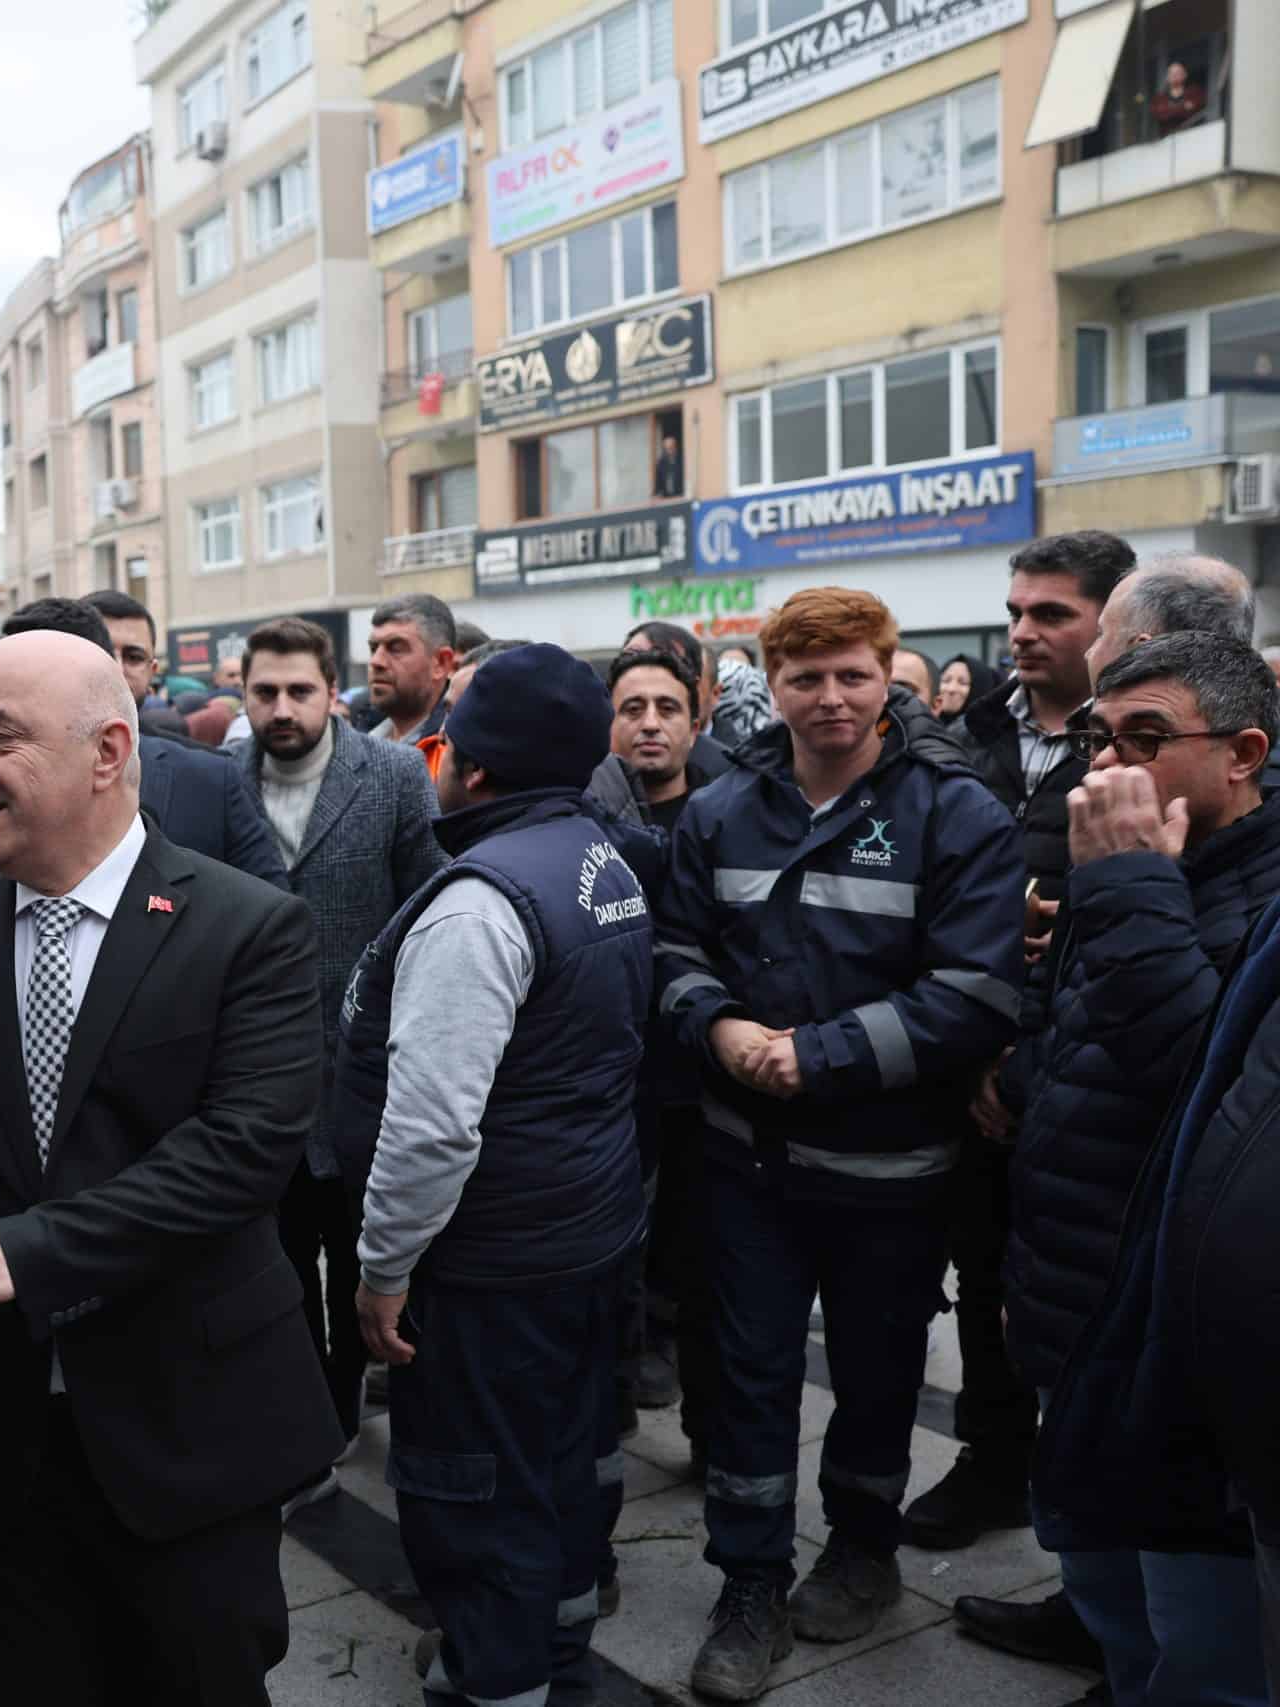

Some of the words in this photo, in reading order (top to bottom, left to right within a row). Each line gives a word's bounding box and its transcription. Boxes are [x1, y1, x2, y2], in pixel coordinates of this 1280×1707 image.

[748, 1, 890, 84] BAYKARA
[900, 464, 1024, 519] İNŞAAT
[852, 849, 891, 861] DARICA
